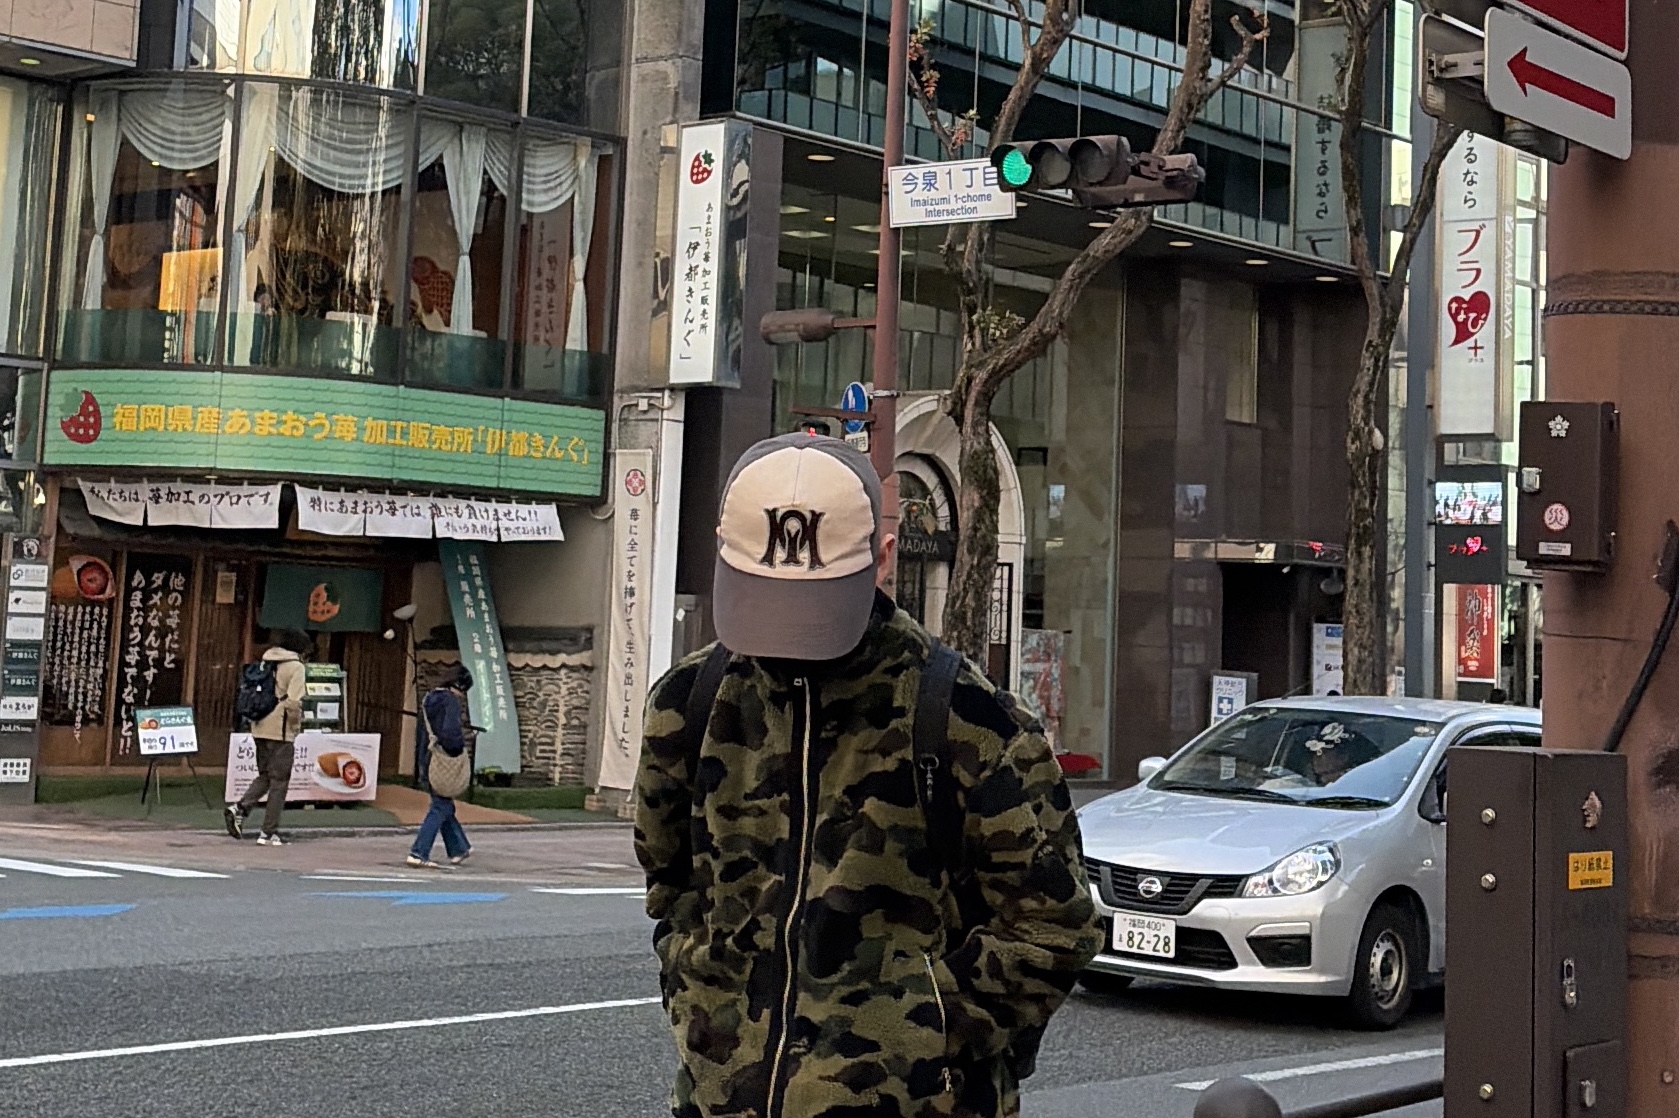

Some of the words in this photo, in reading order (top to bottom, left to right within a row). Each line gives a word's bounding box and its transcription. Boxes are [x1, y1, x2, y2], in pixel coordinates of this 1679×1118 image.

[902, 166, 998, 195] 今泉1丁目
[910, 195, 951, 208] Imaizumi
[954, 192, 992, 205] 1-chome
[925, 205, 978, 218] Intersection
[113, 403, 358, 442] 福岡県産あまおう苺
[1126, 930, 1171, 954] 82-28
